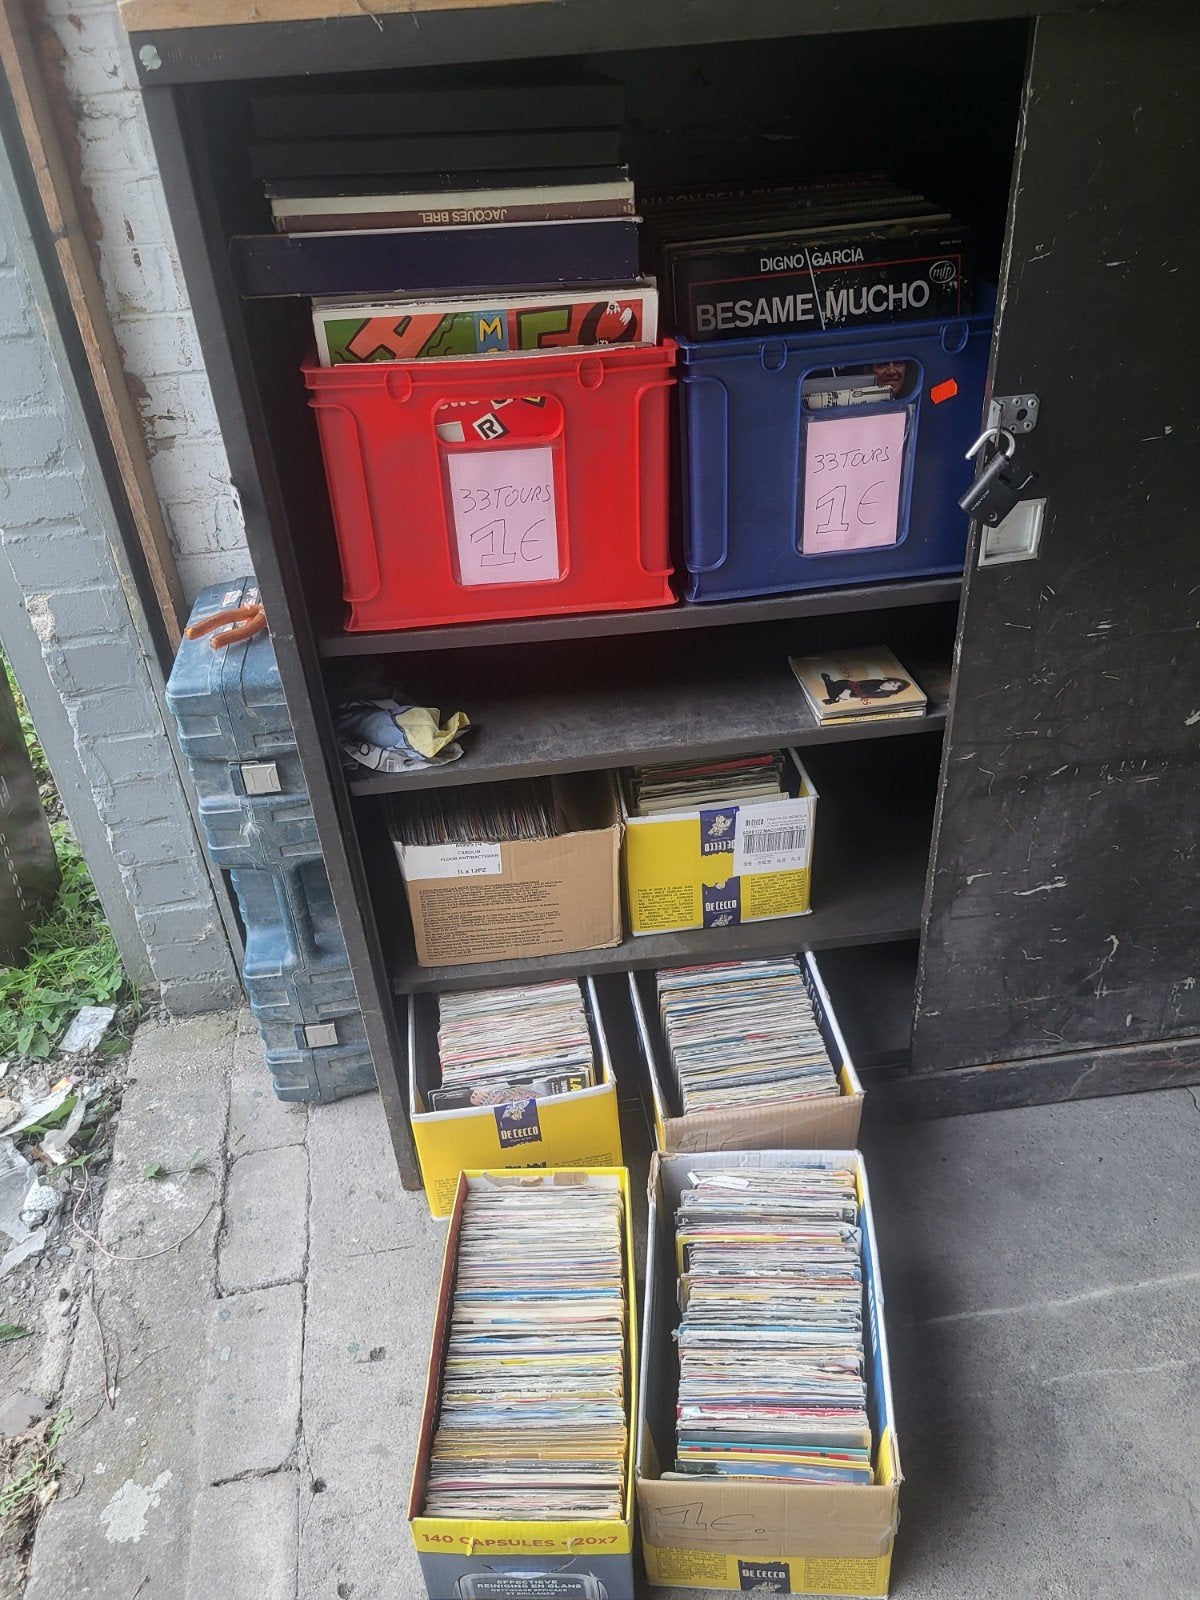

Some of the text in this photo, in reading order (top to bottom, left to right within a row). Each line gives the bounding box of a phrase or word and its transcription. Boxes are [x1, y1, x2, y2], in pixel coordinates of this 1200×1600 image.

[418, 208, 508, 223] JACQUES BREL
[760, 247, 864, 272] DIGNO GARCIA
[696, 279, 930, 332] BESAME MUCHO
[422, 1533, 619, 1548] 140 CAPSULES 20x7
